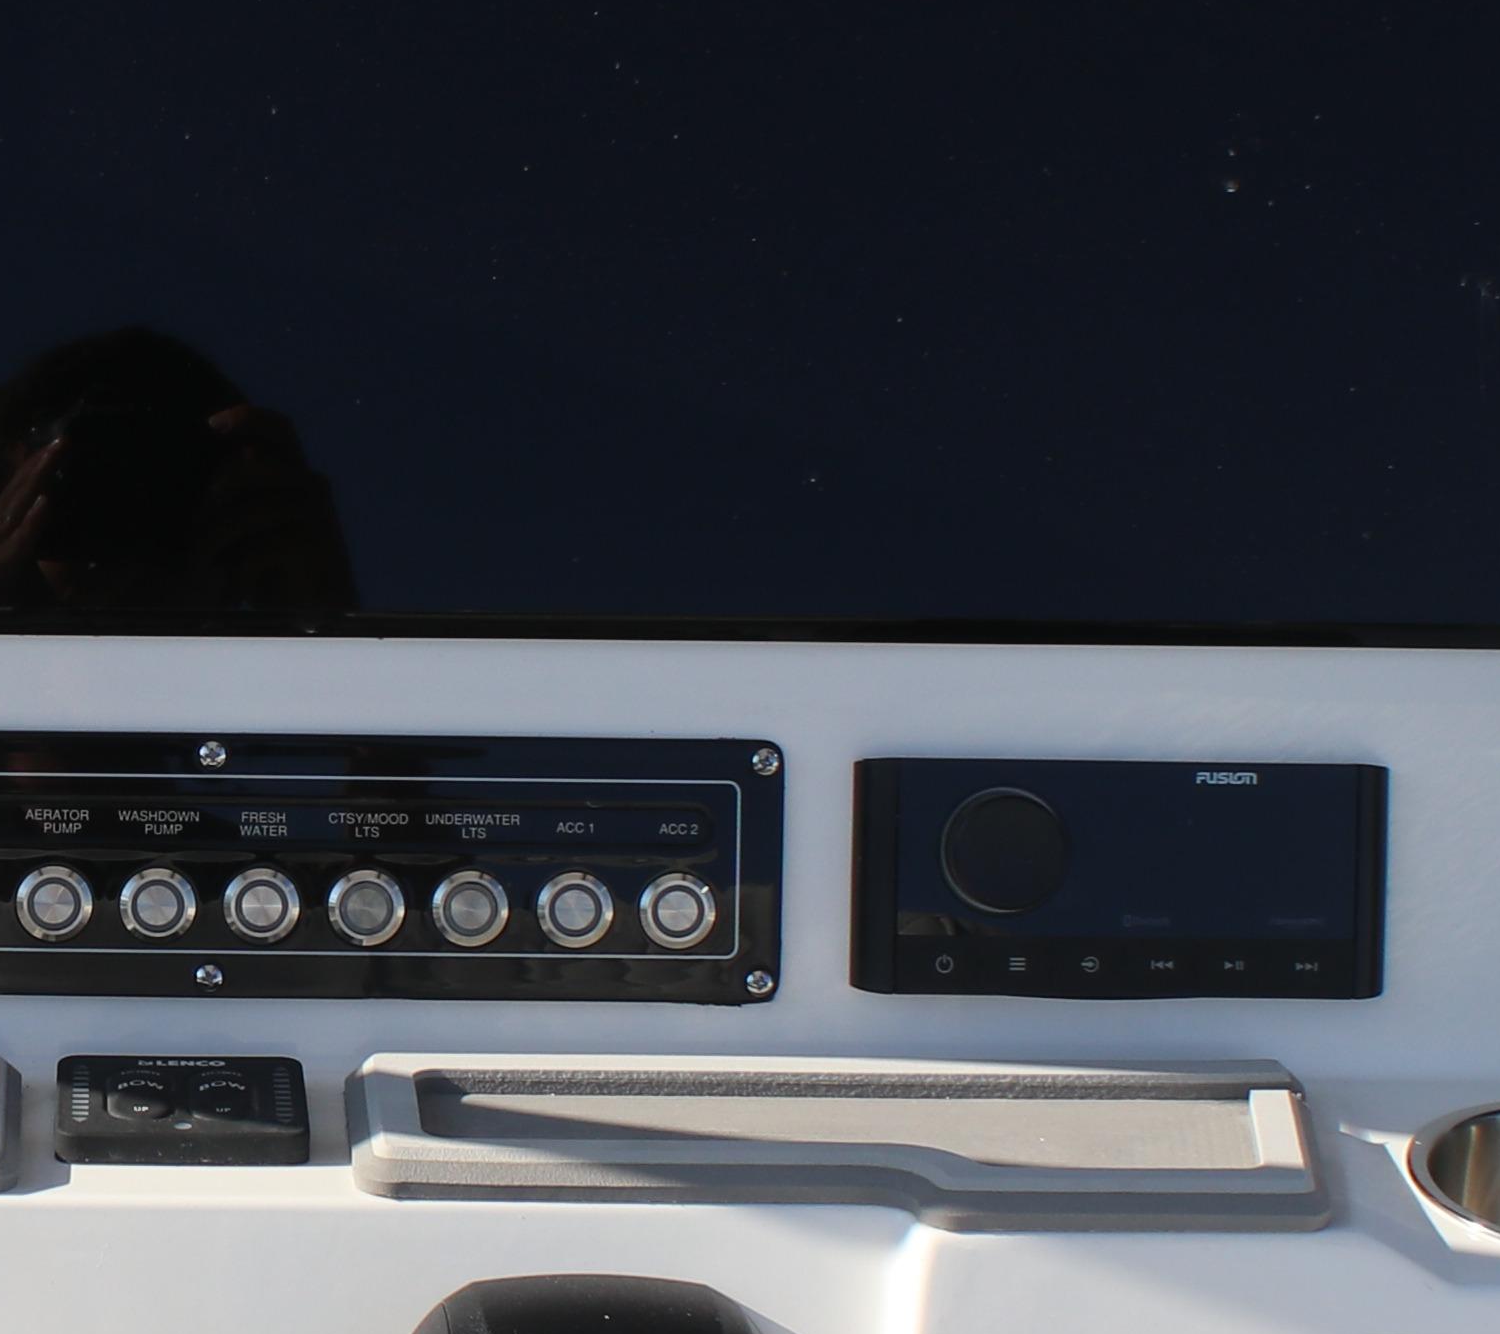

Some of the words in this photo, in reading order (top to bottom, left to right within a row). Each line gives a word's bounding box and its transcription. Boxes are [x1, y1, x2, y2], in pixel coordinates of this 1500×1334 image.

[1195, 771, 1258, 785] FUSION
[25, 809, 90, 822] AERATOR
[118, 810, 200, 823] WASHDOWN
[241, 811, 287, 824] FRESH
[328, 812, 409, 826] CTSY/MOOD
[425, 813, 521, 827] UNDERWATER
[43, 822, 82, 834] PUMP
[144, 823, 184, 835] PUMP
[239, 824, 288, 837] WATER
[355, 825, 380, 838] LTS
[462, 826, 487, 839] LTS
[556, 821, 585, 834] ACC
[588, 822, 596, 835] 1
[659, 822, 688, 835] ACC
[690, 823, 699, 836] 2
[156, 1059, 226, 1068] LENCO
[117, 1078, 164, 1091] BOW
[199, 1079, 246, 1092] BOW
[132, 1105, 150, 1113] UP
